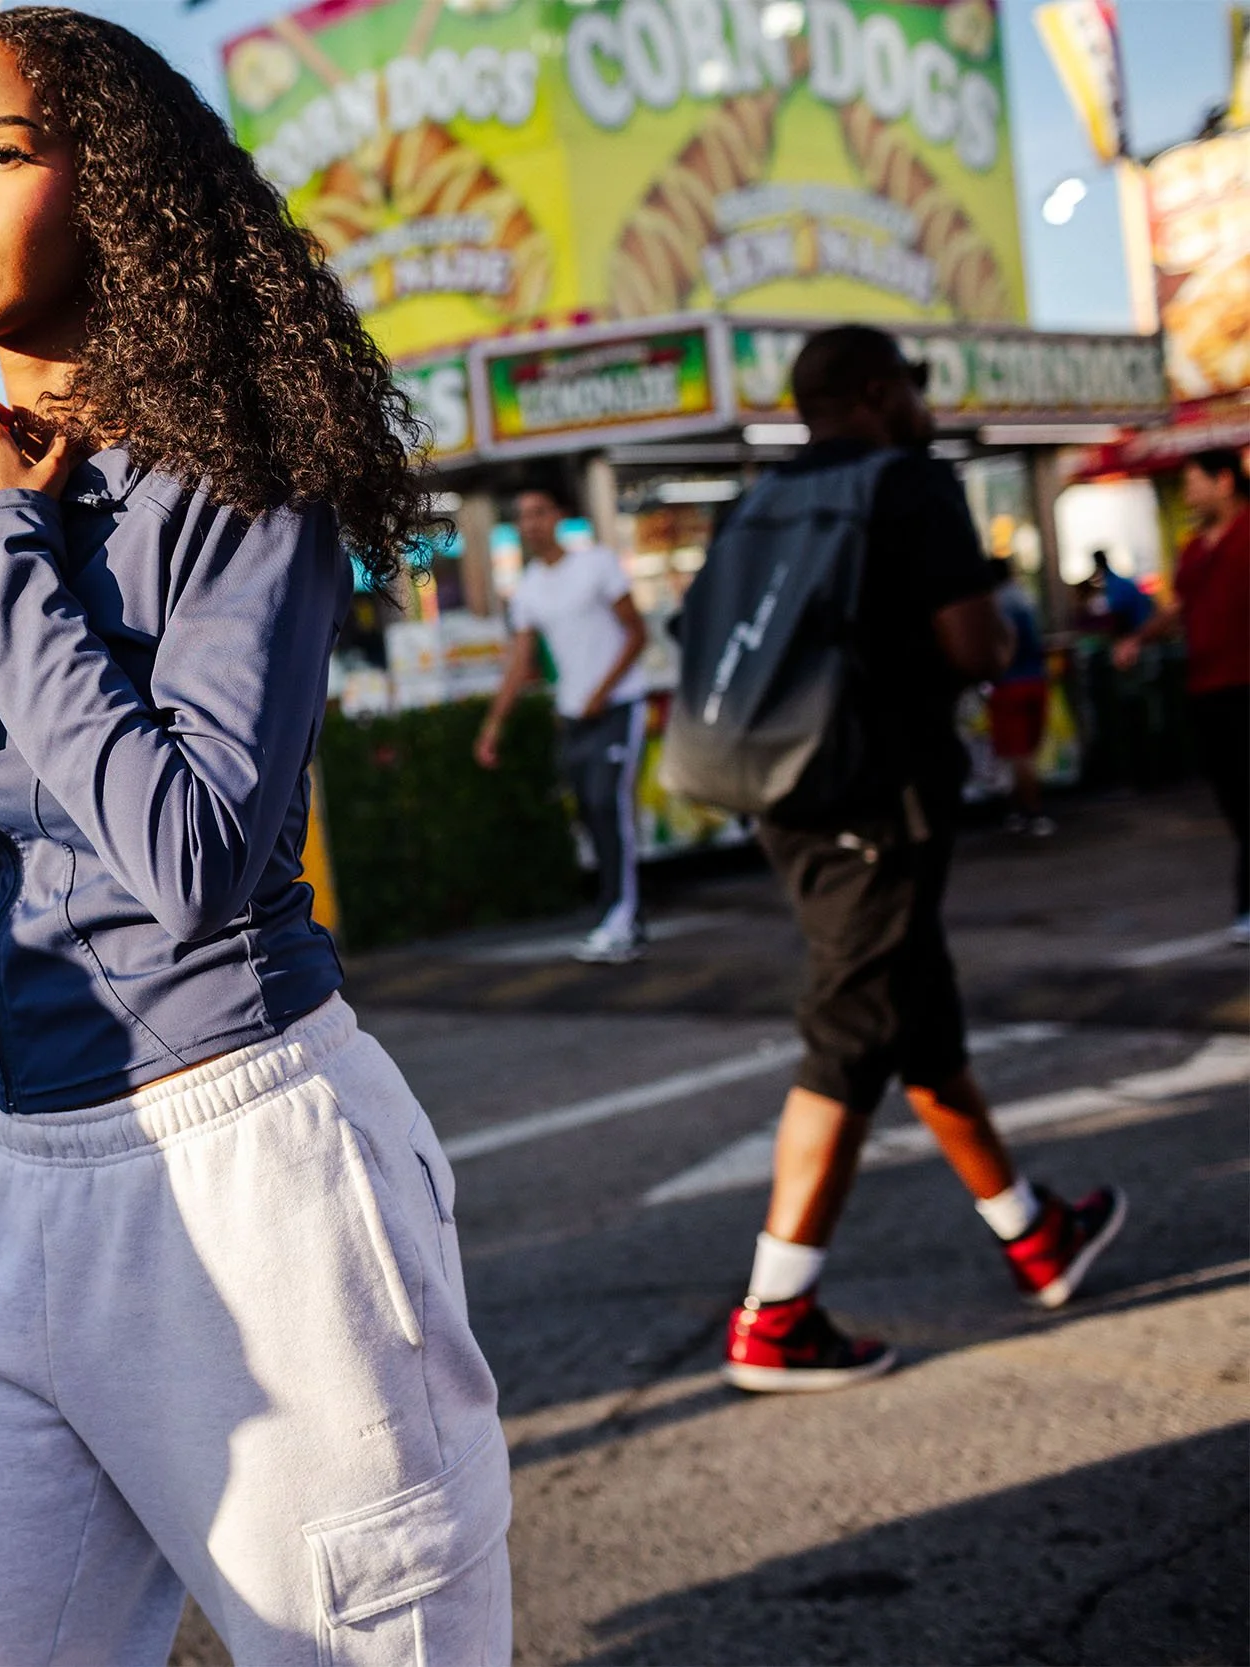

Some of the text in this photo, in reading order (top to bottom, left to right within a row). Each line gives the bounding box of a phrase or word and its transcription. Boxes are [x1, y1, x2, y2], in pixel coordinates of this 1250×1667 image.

[386, 46, 538, 132] DOGS
[566, 0, 793, 130] CORN
[808, 0, 999, 171] DOGS
